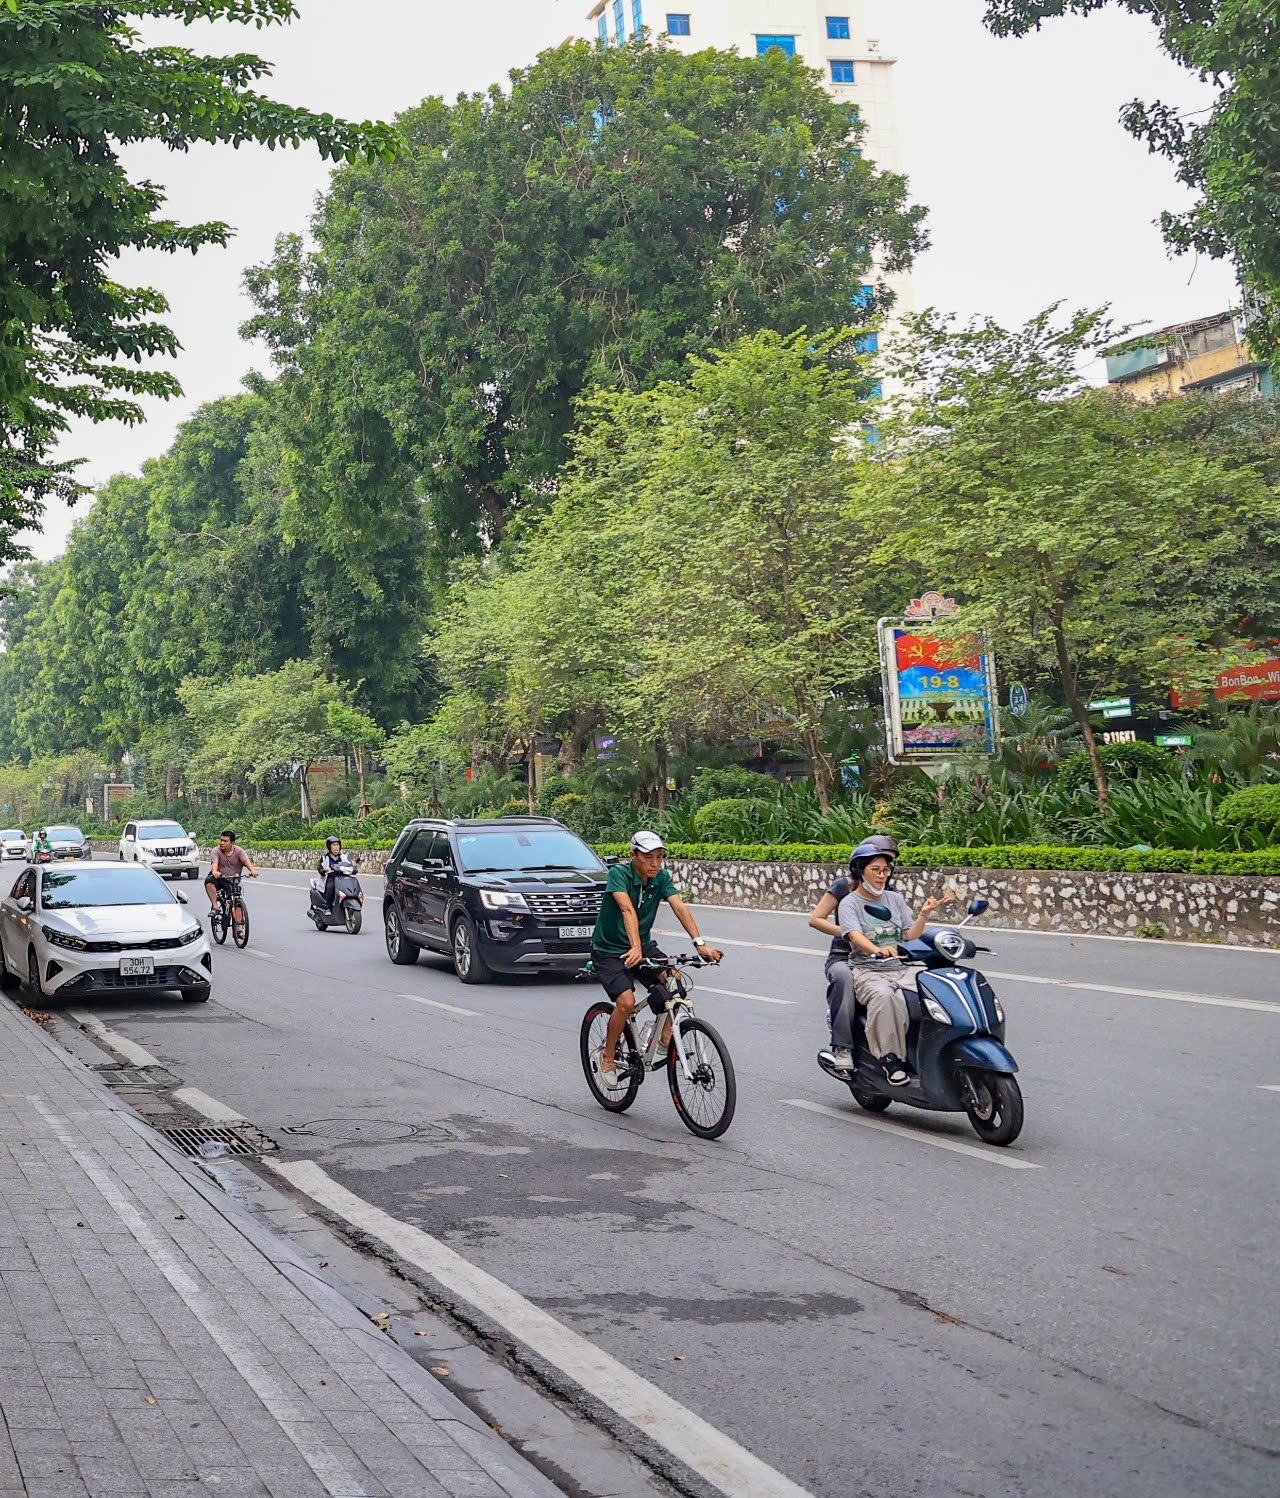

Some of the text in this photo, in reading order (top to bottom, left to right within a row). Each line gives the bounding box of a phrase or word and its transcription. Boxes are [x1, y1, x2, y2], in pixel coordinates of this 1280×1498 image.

[920, 675, 960, 688] 19-8
[1221, 674, 1258, 688] BonBon
[129, 958, 145, 967] 30H
[124, 966, 151, 975] 554.72
